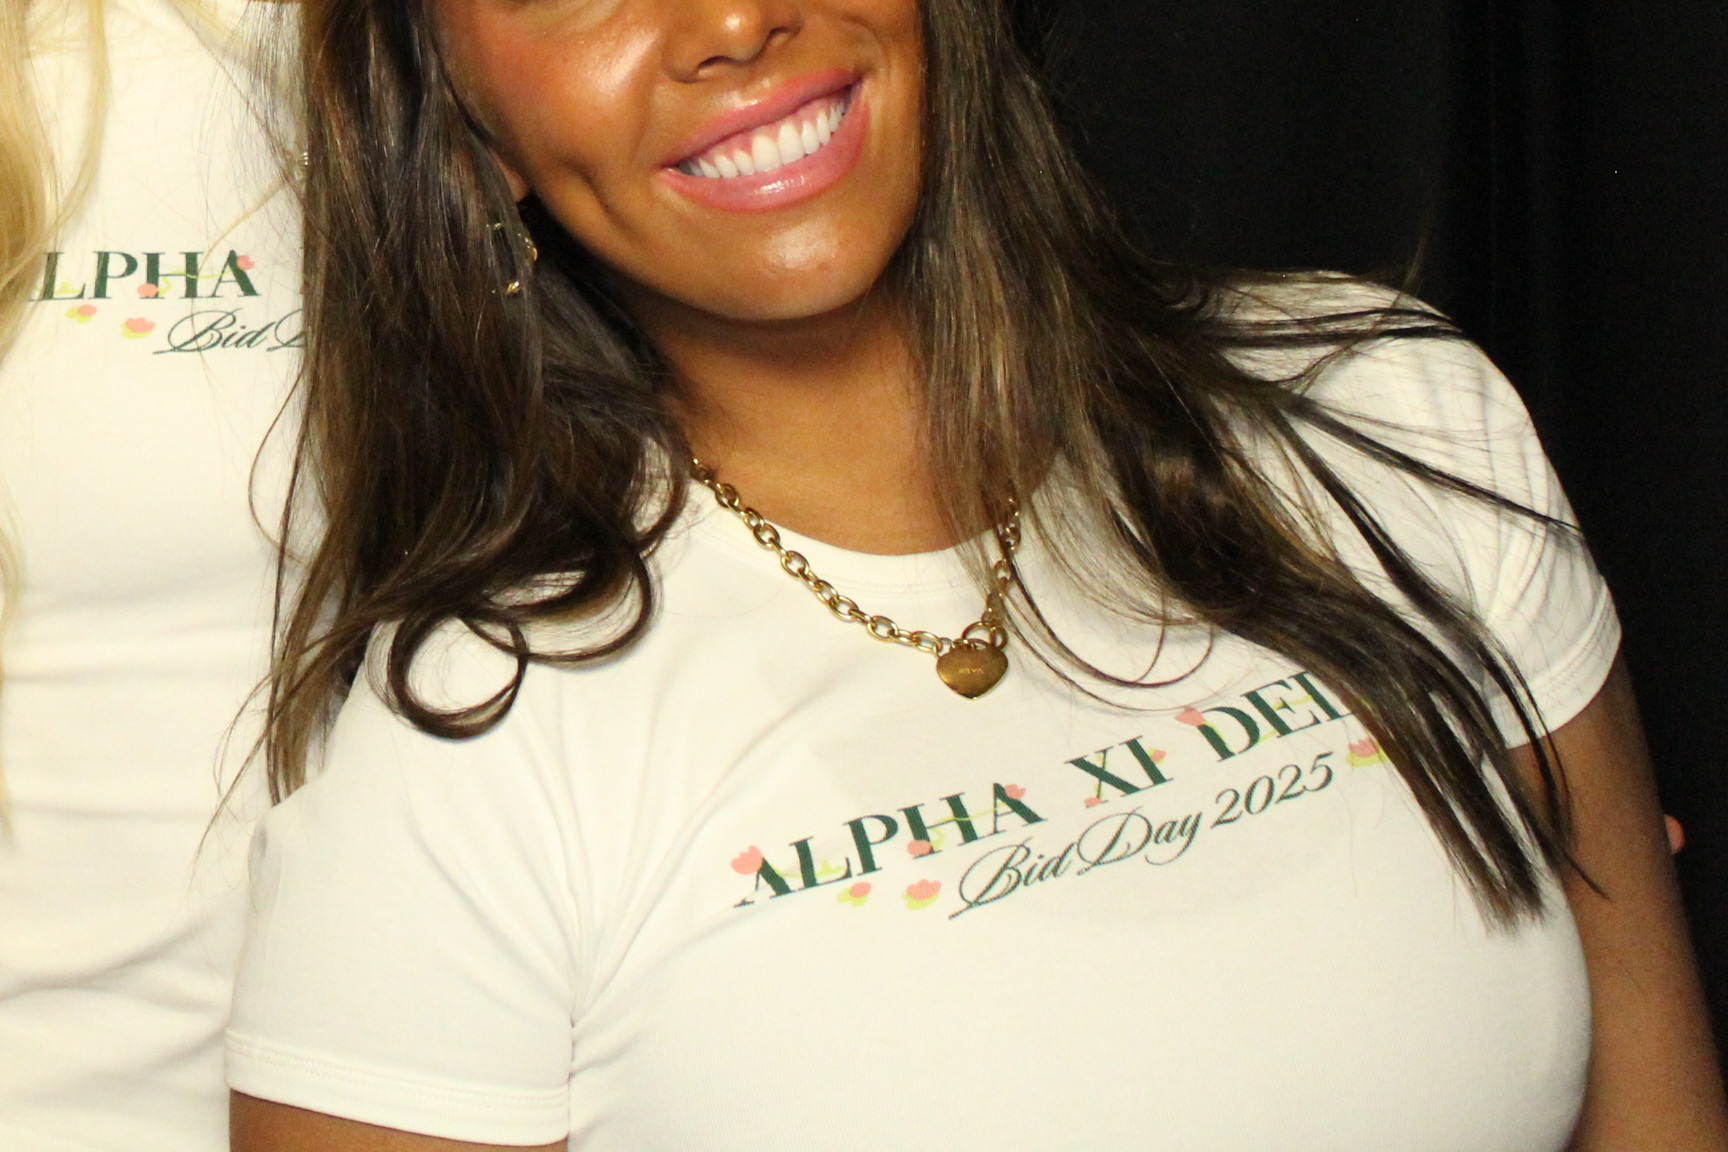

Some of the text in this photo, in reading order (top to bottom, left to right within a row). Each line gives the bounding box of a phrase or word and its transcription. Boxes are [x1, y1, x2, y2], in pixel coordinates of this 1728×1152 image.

[29, 249, 262, 302] LPHA
[153, 307, 276, 355] Bid
[733, 671, 1357, 909] ALPHA XI DEL
[948, 751, 1335, 920] Bid Day 2025
